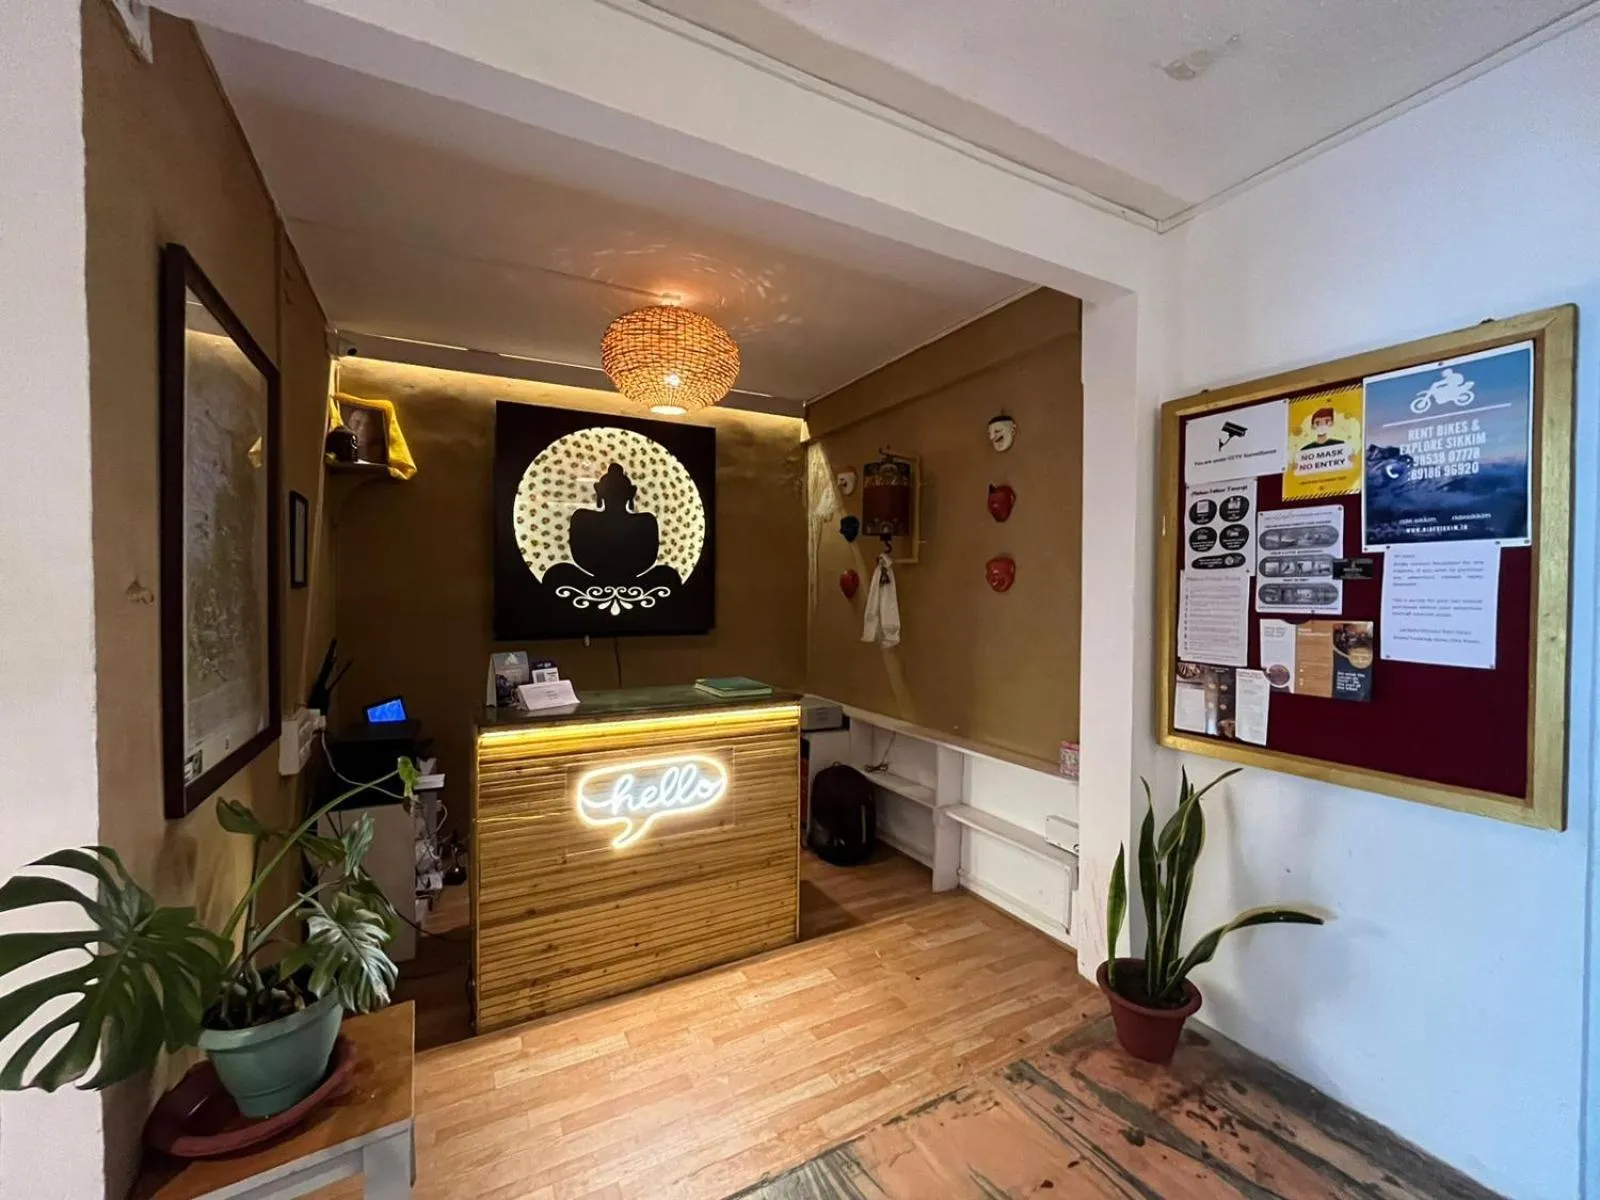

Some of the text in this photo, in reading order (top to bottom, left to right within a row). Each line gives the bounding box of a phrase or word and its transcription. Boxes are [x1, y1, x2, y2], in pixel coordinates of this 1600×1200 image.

[1408, 418, 1480, 441] RENT BIKES &
[1399, 431, 1486, 456] EXPLORE SIKKIM
[1301, 449, 1344, 461] NO MASK
[1314, 458, 1346, 469] ENTRY
[1444, 461, 1480, 477] 96920
[592, 763, 723, 816] hello
